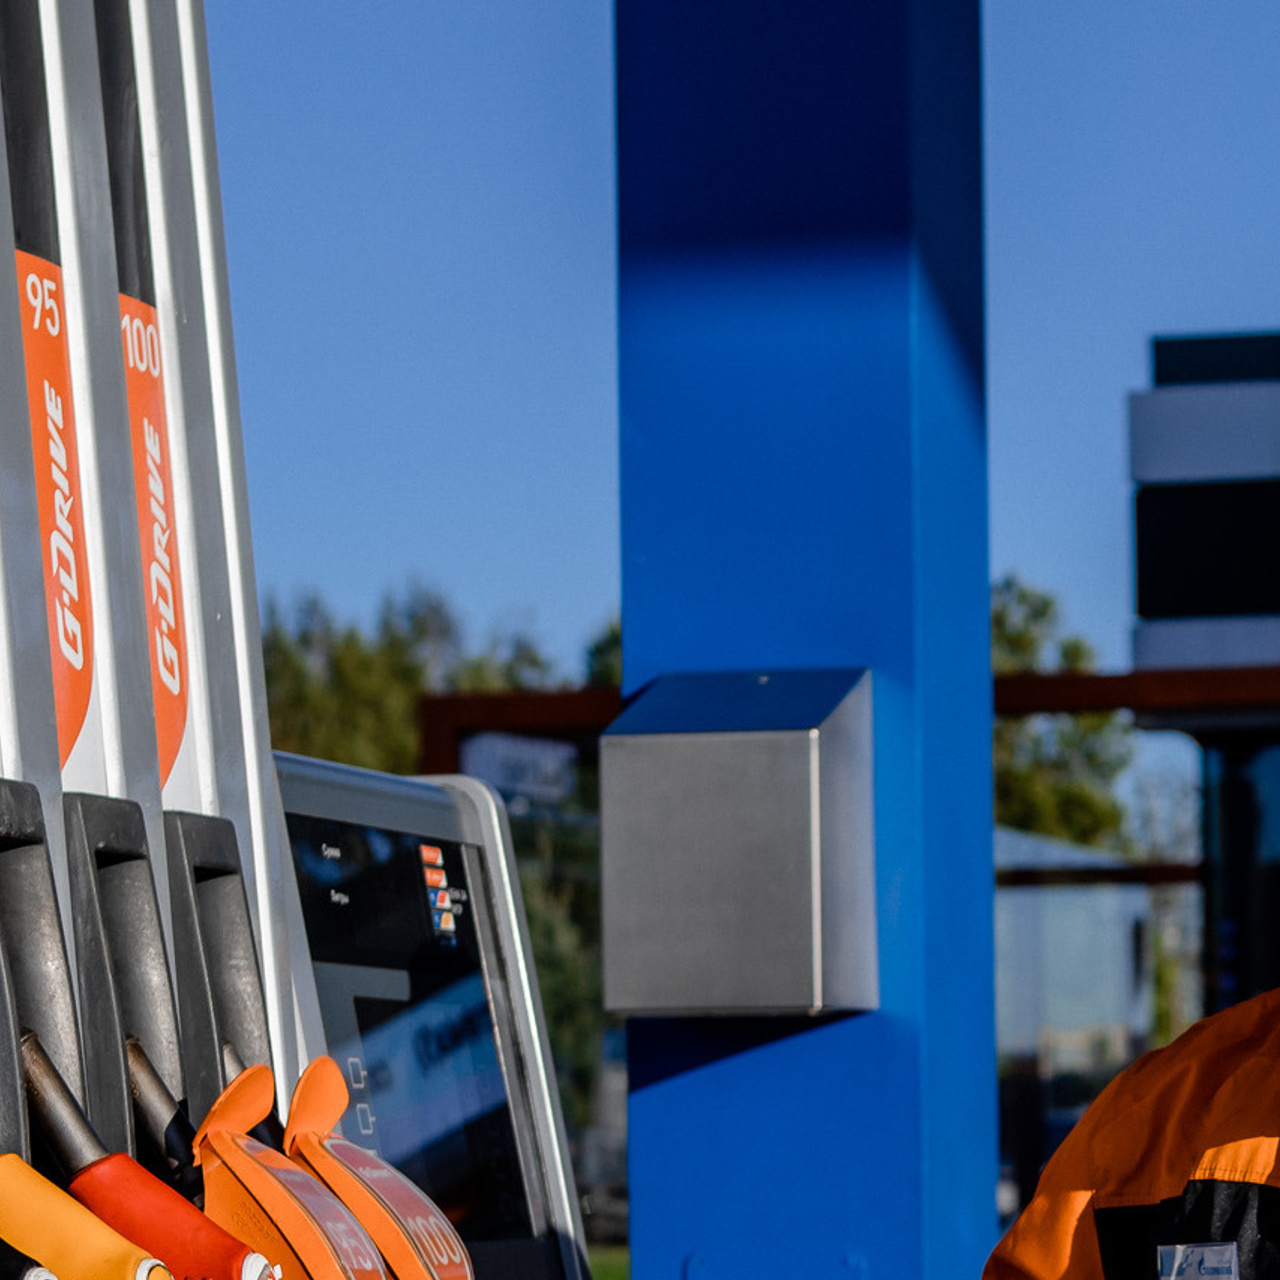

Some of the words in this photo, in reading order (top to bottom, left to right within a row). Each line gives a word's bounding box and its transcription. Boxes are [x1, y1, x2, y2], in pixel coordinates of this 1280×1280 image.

[26, 273, 60, 337] 95
[121, 314, 161, 377] 100
[406, 1215, 462, 1266] 100
